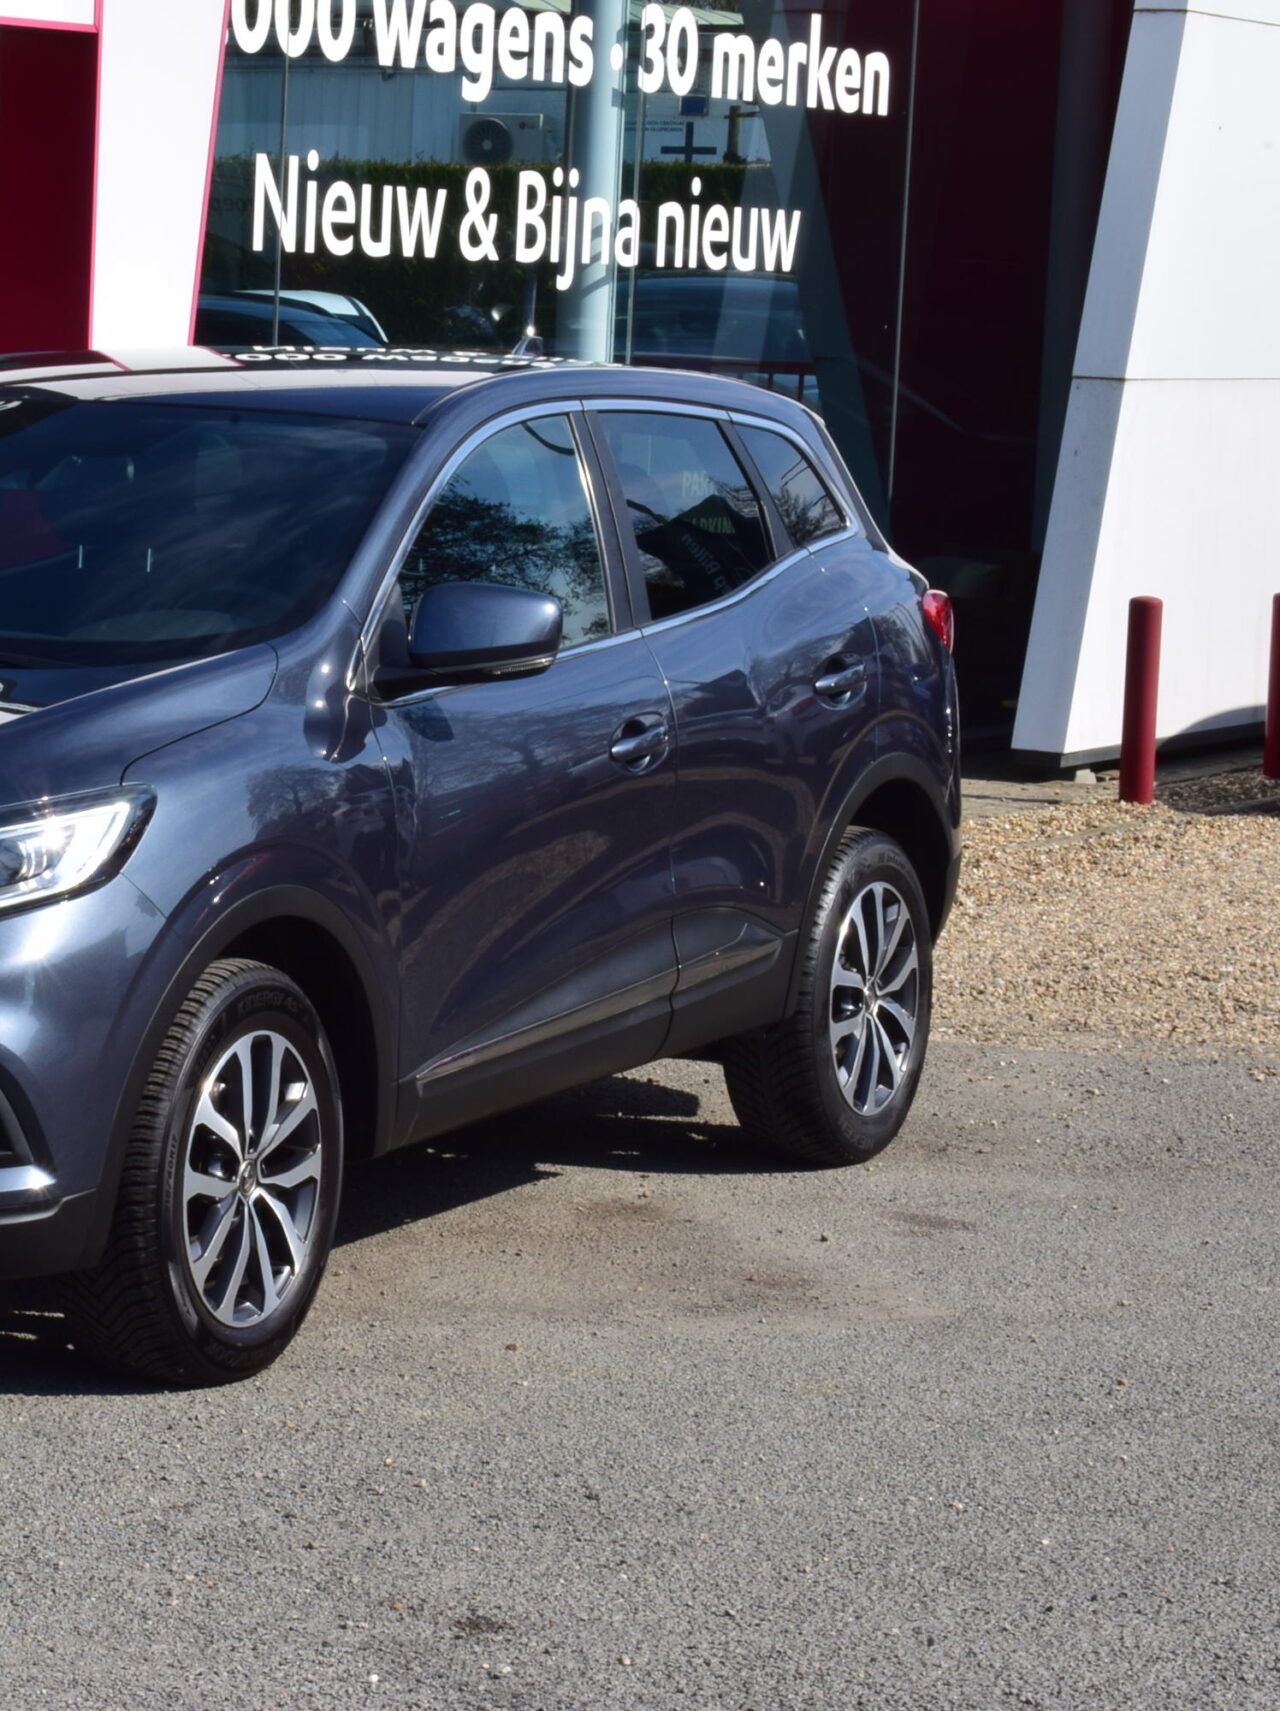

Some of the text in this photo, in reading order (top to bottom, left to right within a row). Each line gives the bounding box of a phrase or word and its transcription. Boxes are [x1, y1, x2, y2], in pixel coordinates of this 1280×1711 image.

[225, 0, 891, 117] 000 wagens 30 merken
[251, 148, 802, 292] Nieuw & Bijna nieuw
